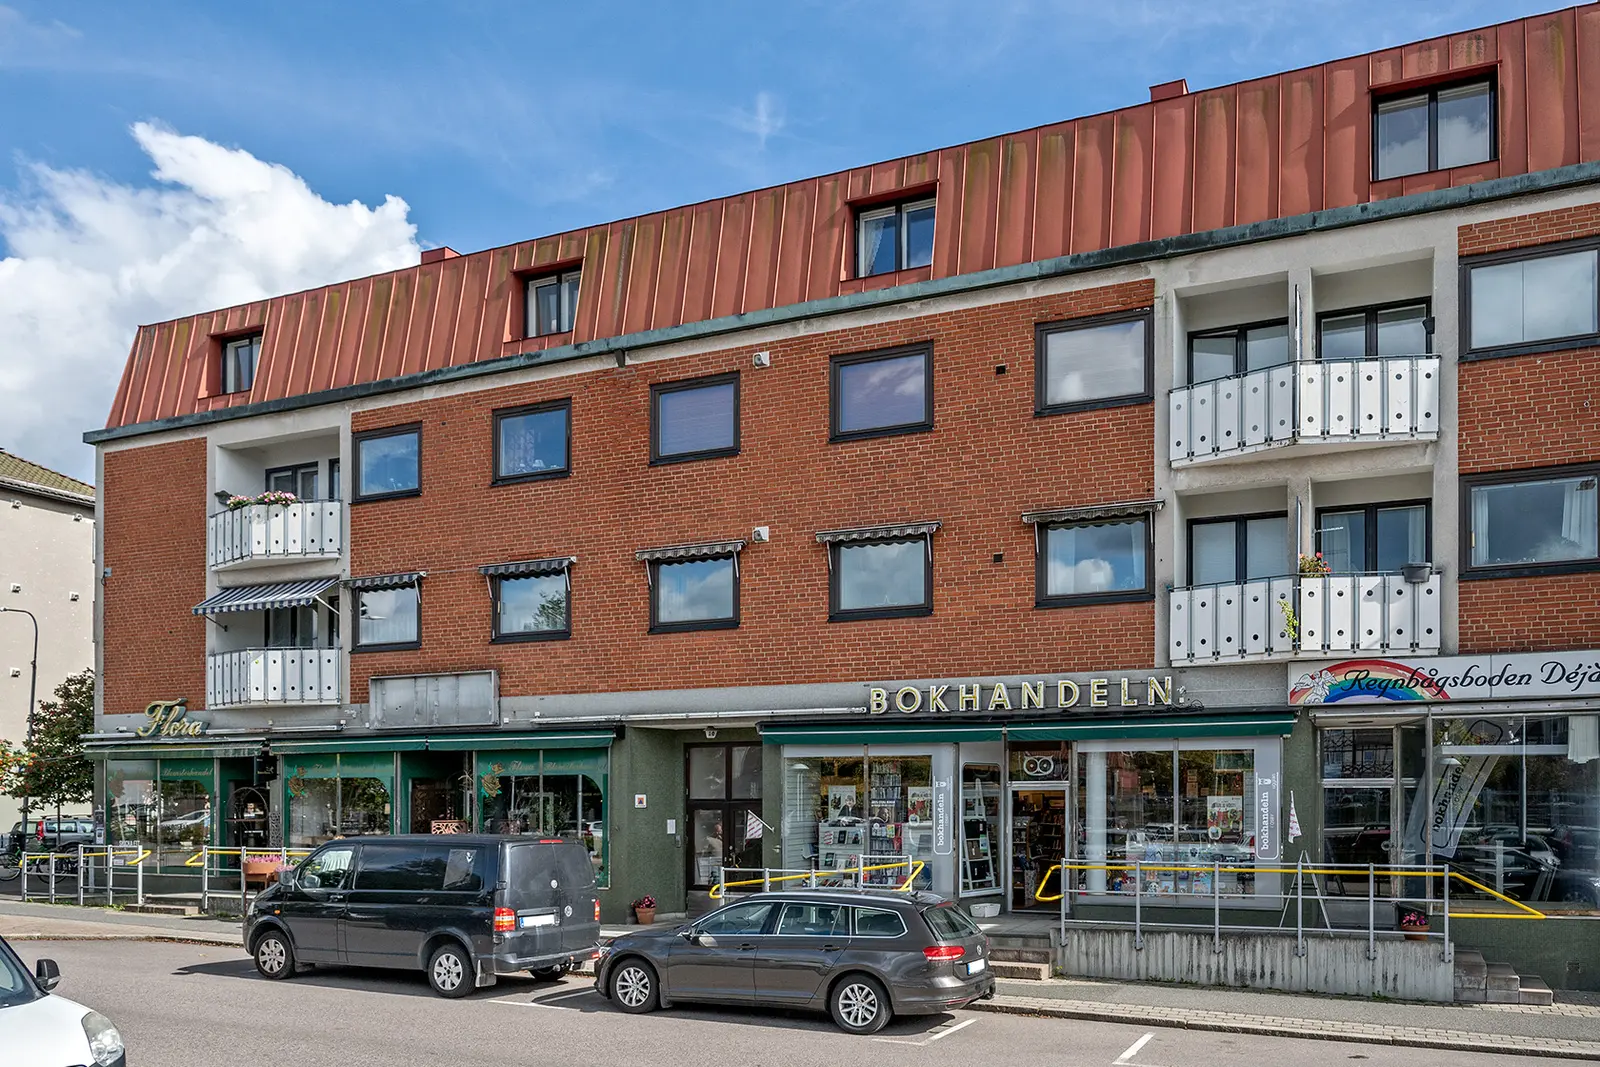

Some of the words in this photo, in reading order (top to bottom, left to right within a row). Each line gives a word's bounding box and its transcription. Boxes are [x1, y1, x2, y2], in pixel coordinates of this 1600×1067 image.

[869, 676, 1172, 715] BOKHANDELN
[1341, 664, 1532, 698] Regnbågsboden
[137, 697, 204, 737] Flora
[1261, 792, 1269, 850] bokhandeln
